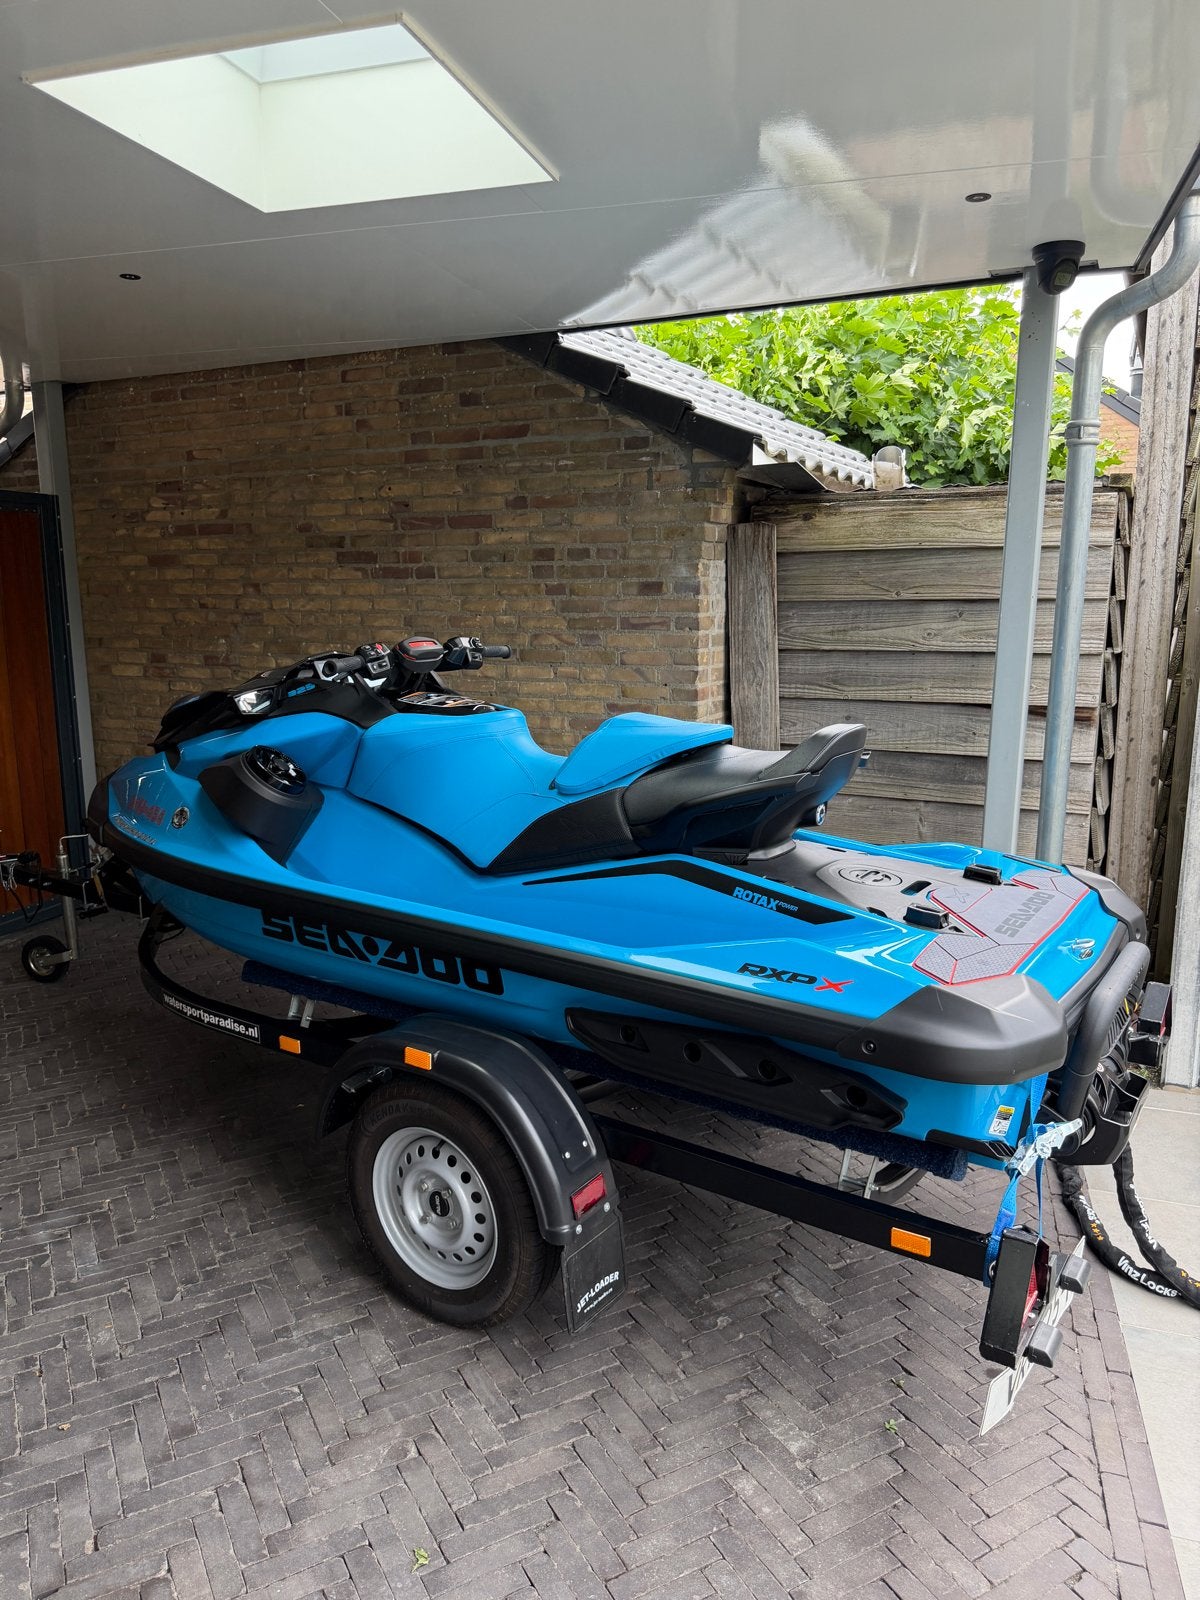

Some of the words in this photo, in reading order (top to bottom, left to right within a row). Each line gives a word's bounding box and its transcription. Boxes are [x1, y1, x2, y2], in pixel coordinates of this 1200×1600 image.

[733, 886, 780, 911] ROTAX
[778, 901, 799, 912] POWER
[163, 993, 258, 1038] watersportparadise.nl
[577, 1270, 620, 1313] JET-LOADER
